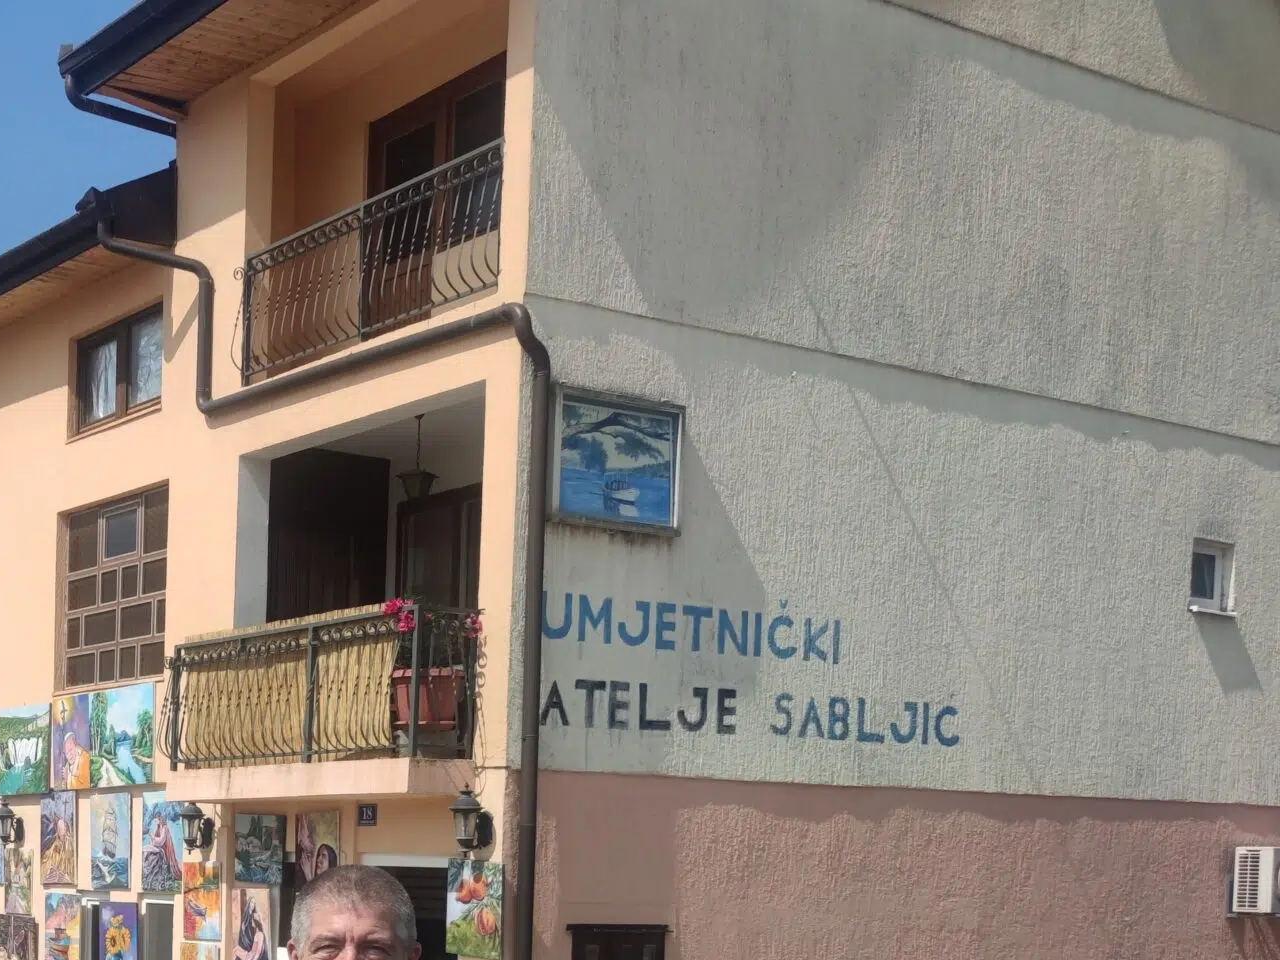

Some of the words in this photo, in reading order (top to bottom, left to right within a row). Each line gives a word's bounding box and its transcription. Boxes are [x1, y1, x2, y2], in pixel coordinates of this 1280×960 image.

[541, 591, 840, 664] UMJETNIČKI
[540, 679, 736, 734] ATELJE
[361, 806, 373, 820] 18
